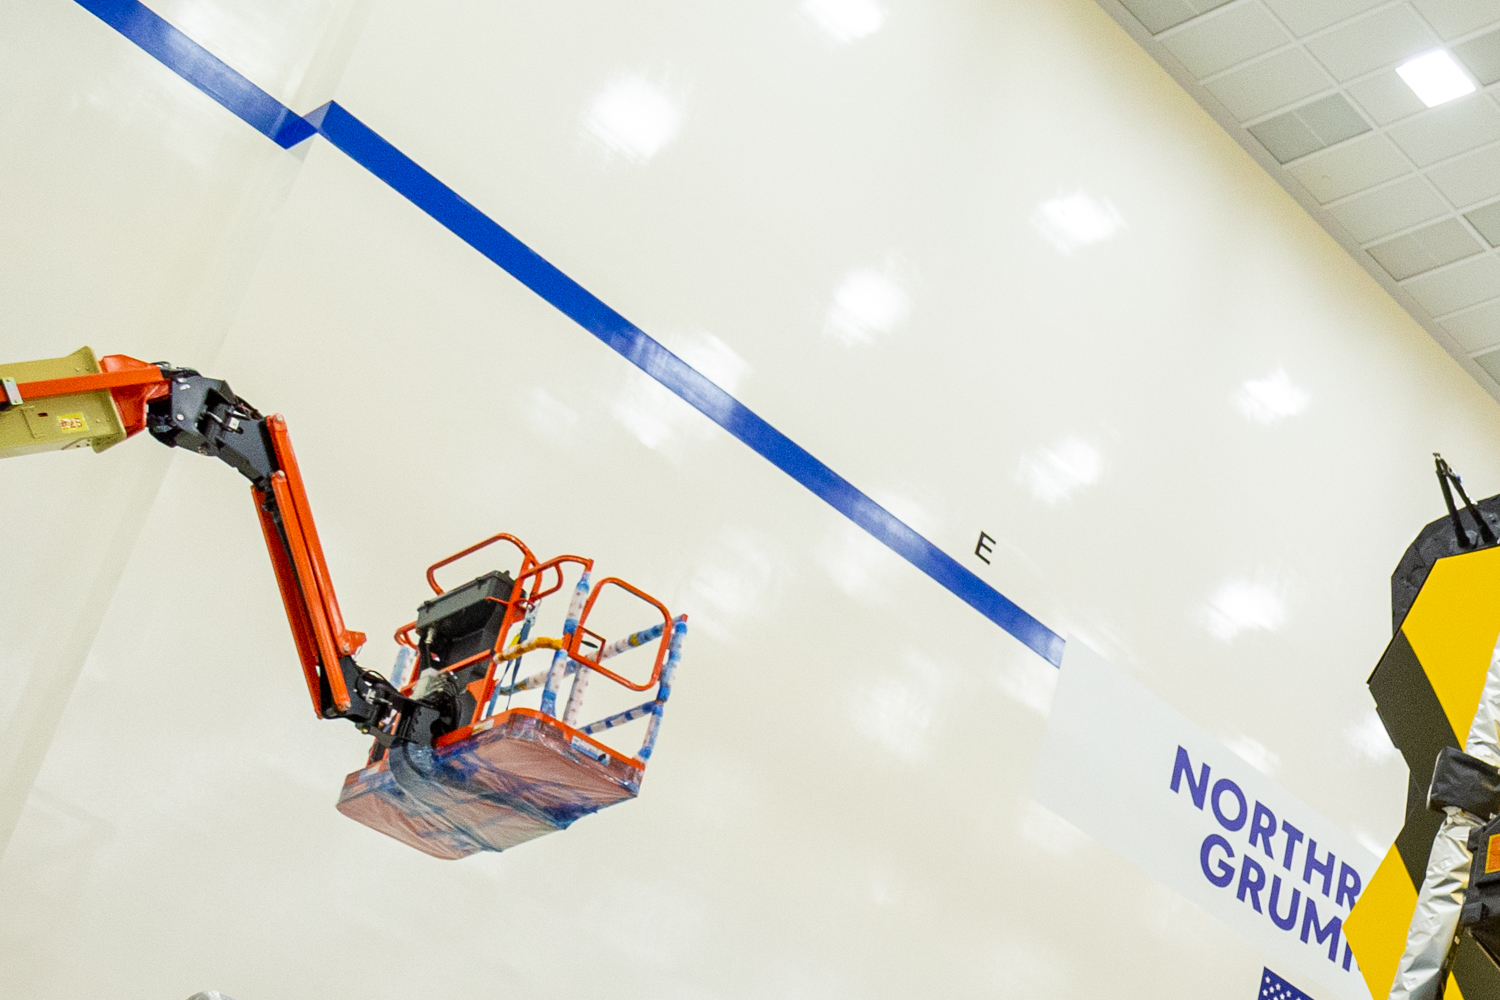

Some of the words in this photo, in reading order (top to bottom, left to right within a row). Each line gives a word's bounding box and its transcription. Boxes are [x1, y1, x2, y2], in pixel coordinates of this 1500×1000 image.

[974, 530, 996, 565] E
[1170, 744, 1362, 911] NORTHR
[1200, 833, 1353, 973] GRUM
